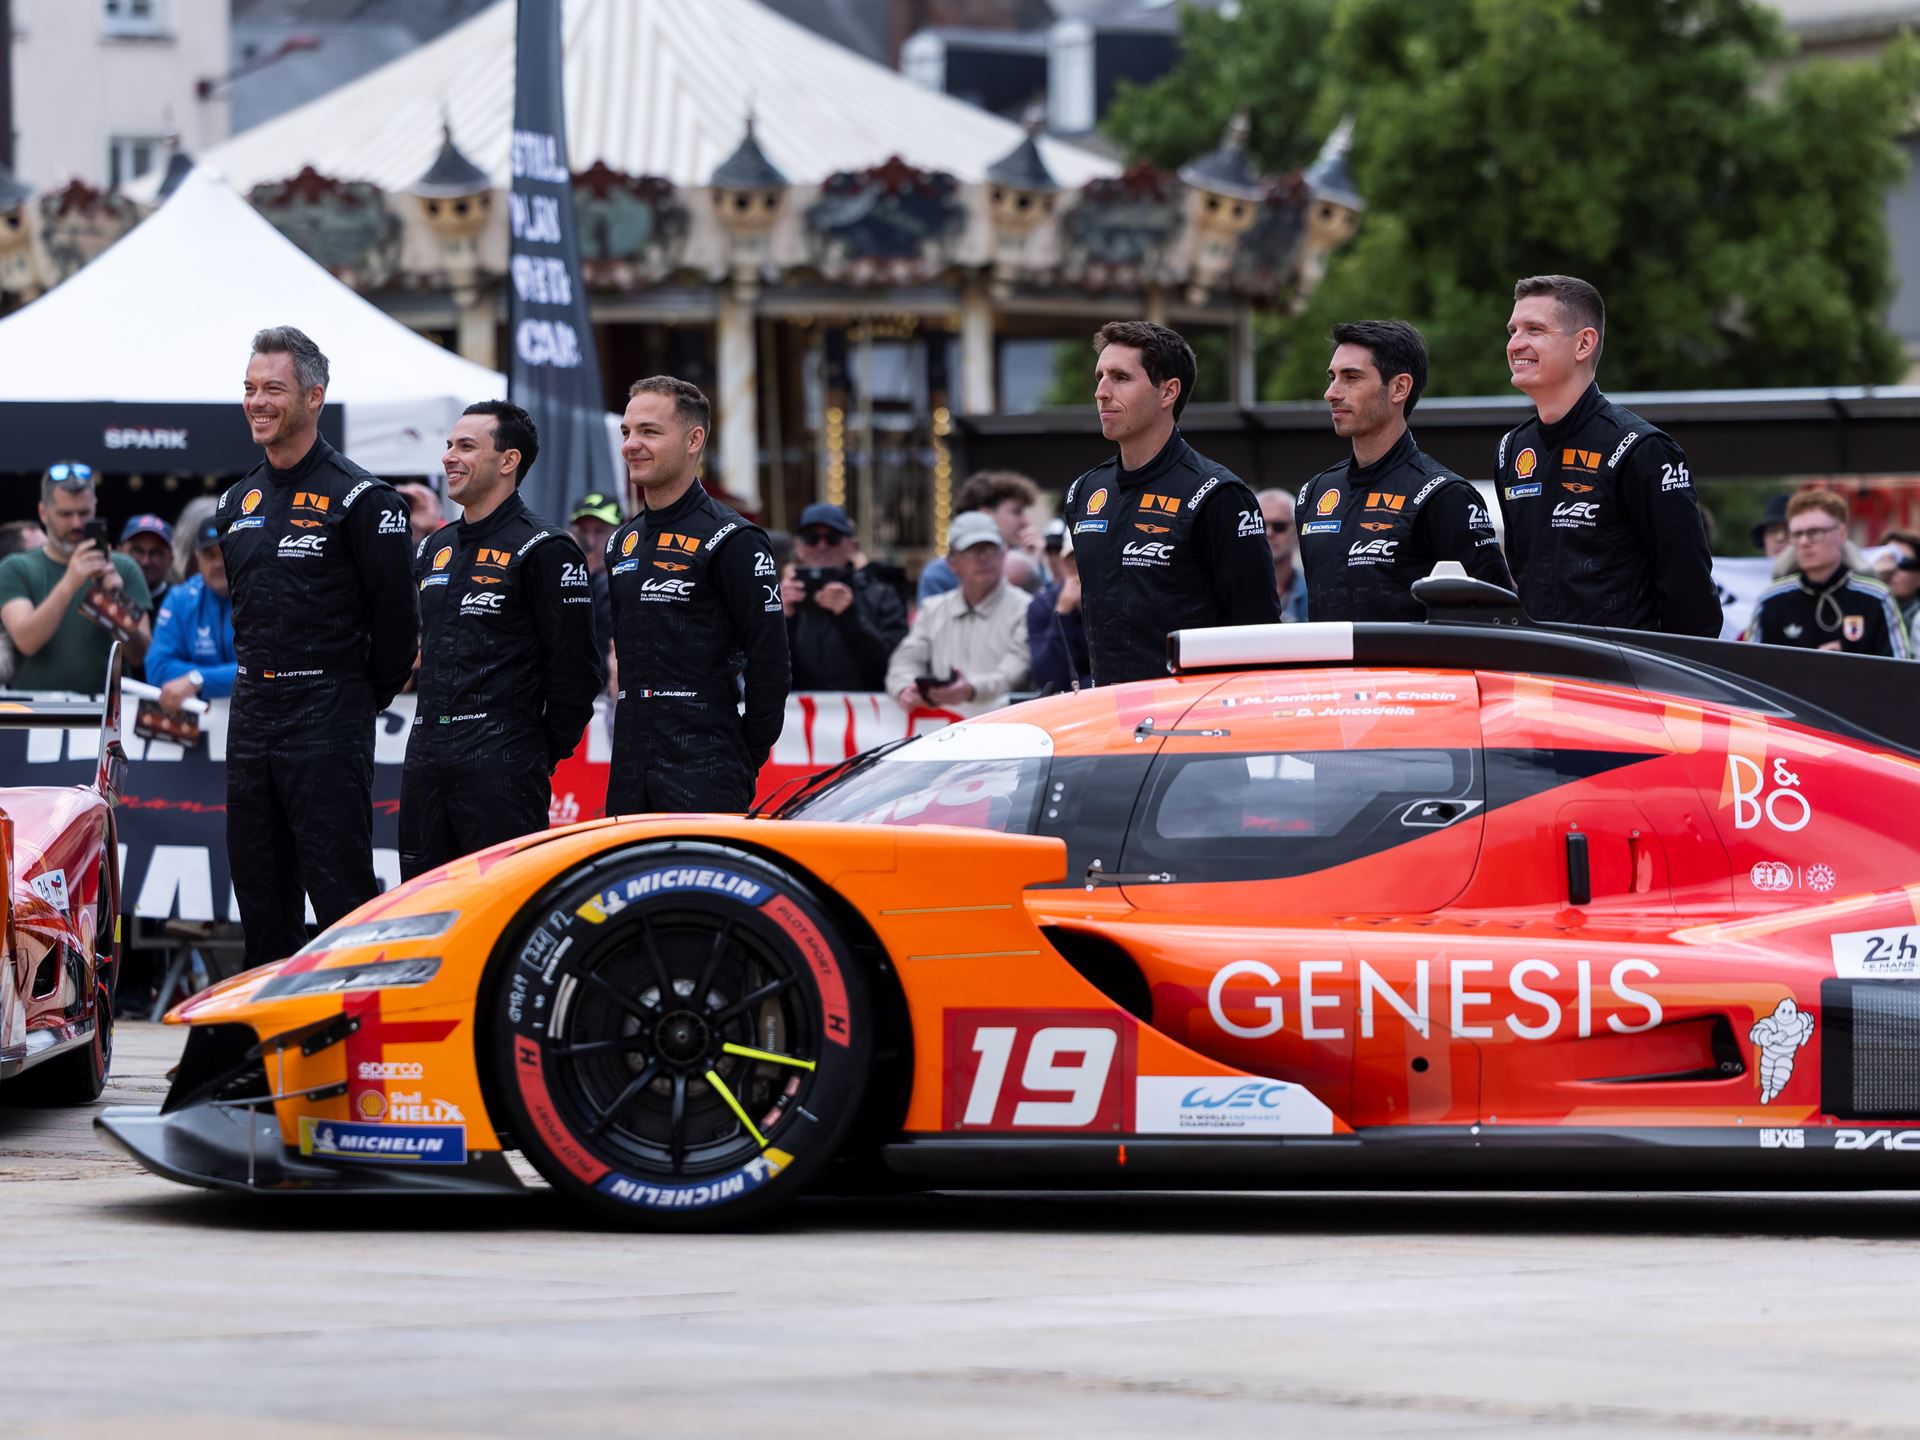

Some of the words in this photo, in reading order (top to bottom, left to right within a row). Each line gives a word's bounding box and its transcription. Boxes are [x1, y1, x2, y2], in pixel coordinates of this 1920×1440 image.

[104, 428, 188, 449] SPARK
[1607, 431, 1638, 468] sparco
[1660, 461, 1690, 486] 24h
[342, 480, 372, 508] sparco
[1187, 477, 1220, 511] sparco
[1413, 476, 1447, 505] sparco
[1661, 483, 1672, 492] LE
[1673, 482, 1691, 490] MANS
[379, 509, 406, 528] 24h
[1238, 508, 1265, 531] 24h
[1552, 502, 1600, 519] WEC
[278, 534, 328, 550] WEC
[517, 530, 550, 556] sparco
[704, 522, 738, 551] sparco
[1238, 530, 1247, 538] LE
[1248, 528, 1265, 536] MANS
[1122, 541, 1175, 559] WEC
[1348, 539, 1399, 556] WEC
[561, 562, 588, 581] 24h
[641, 578, 696, 596] WEC
[461, 592, 506, 608] WEC
[653, 690, 698, 698] M.JAUBERT
[1242, 697, 1262, 705] M.
[452, 713, 488, 722] P.DERANI
[1296, 708, 1314, 718] D.
[626, 868, 760, 900] MICHELIN
[1753, 867, 1789, 886] FIA
[777, 904, 809, 936] PILOT
[806, 933, 832, 976] SPORT
[1863, 932, 1918, 962] 24h
[1207, 958, 1664, 1040] GENESIS
[827, 1014, 846, 1035] H
[520, 1045, 538, 1066] H
[358, 1061, 424, 1080] sparco
[962, 1026, 1119, 1127] 19
[390, 1091, 422, 1105] Shell
[1181, 1083, 1288, 1108] WEC
[391, 1098, 465, 1122] HELIX
[338, 1134, 444, 1153] MICHELIN
[1759, 1128, 1805, 1148] HEXIS
[609, 1174, 745, 1207] MICHELIN
